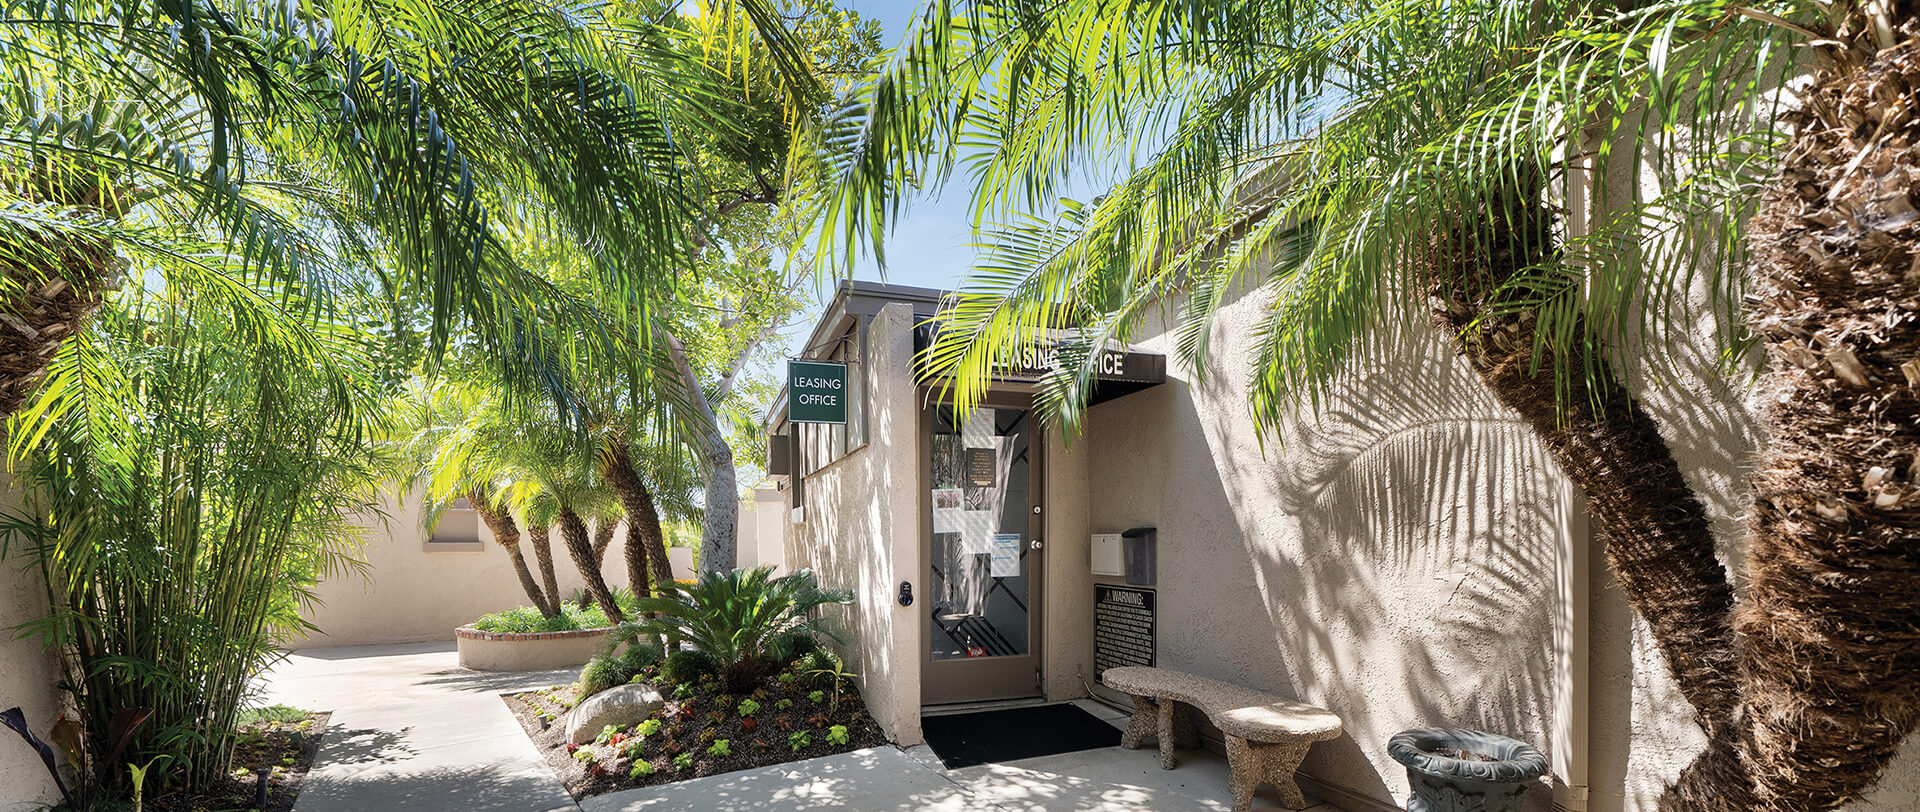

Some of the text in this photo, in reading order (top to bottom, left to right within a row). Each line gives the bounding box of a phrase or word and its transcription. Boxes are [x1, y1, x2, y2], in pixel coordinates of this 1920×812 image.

[794, 376, 841, 390] LEASING
[799, 393, 837, 406] OFFICE
[1112, 590, 1144, 606] WARNING:
